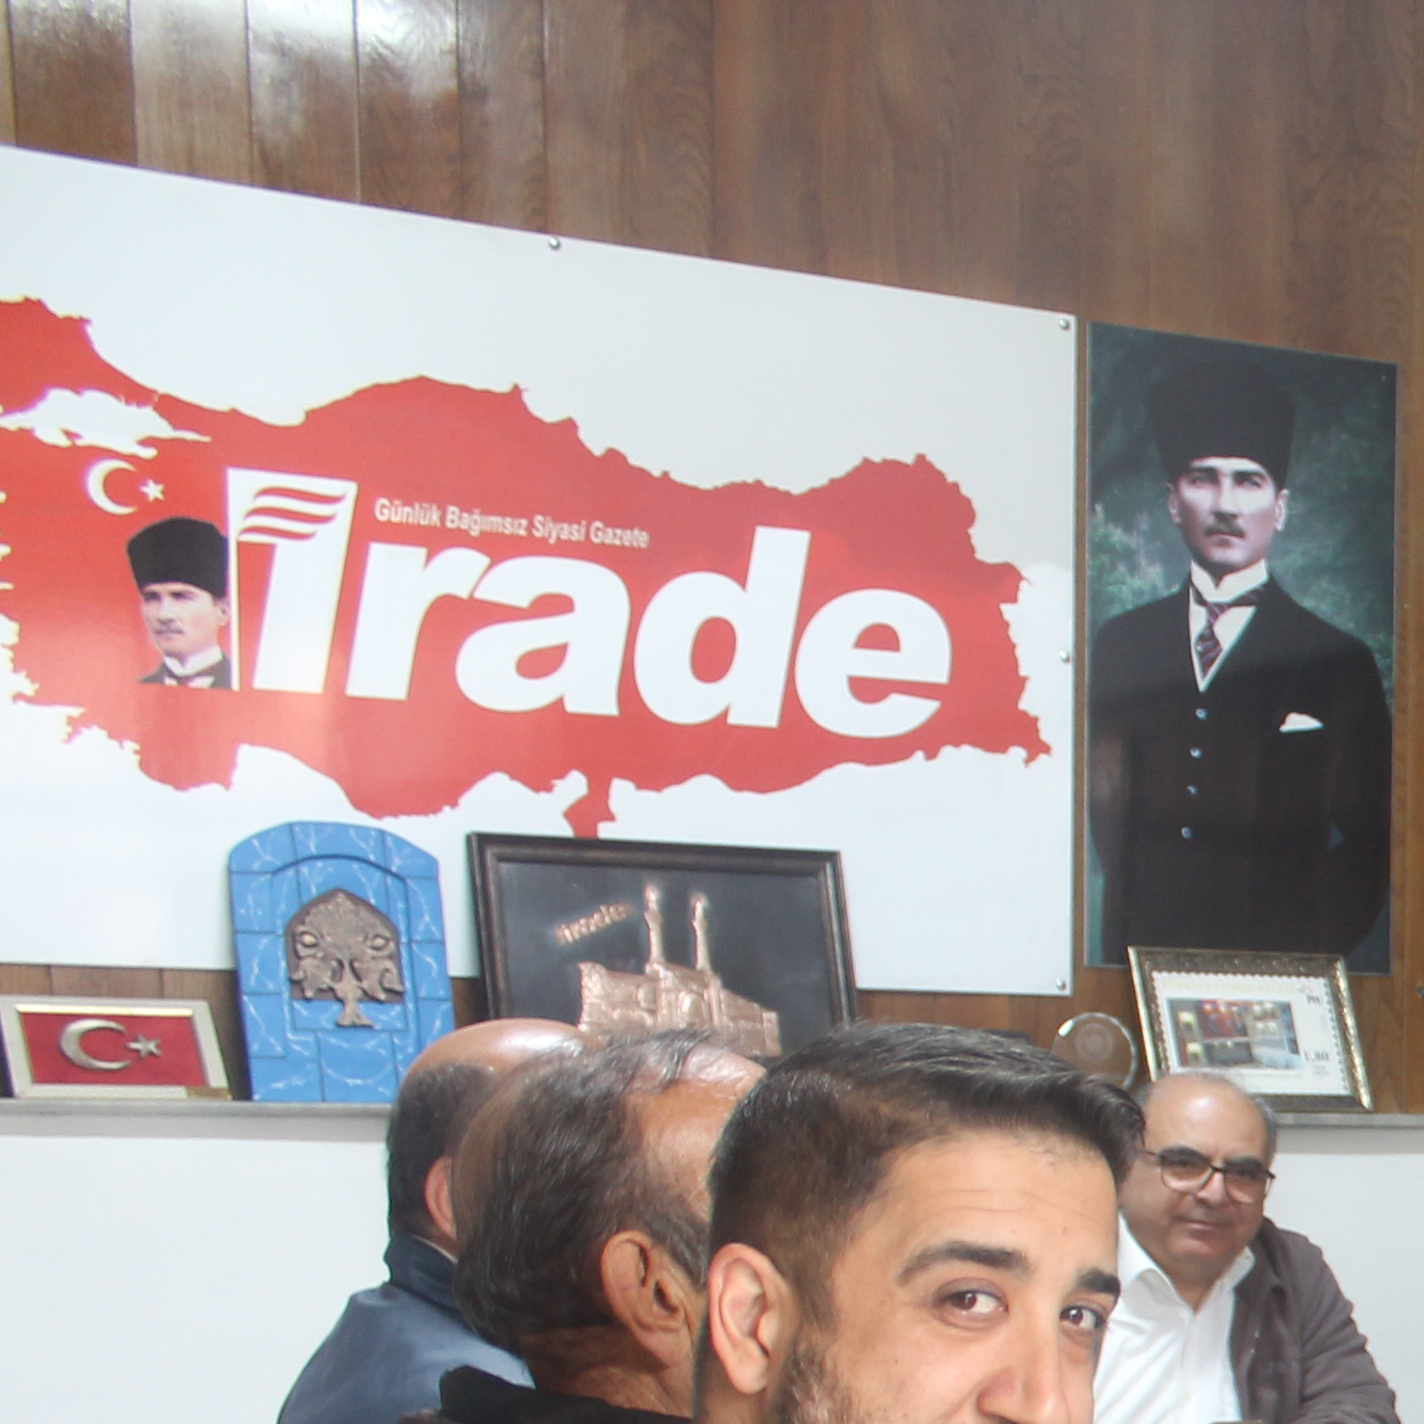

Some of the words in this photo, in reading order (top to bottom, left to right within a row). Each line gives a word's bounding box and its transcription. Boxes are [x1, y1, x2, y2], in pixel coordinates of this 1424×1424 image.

[374, 498, 440, 527] Günlük
[445, 505, 527, 536] Bağımsız
[532, 515, 586, 543] Siyasi
[589, 521, 650, 549] Gazete
